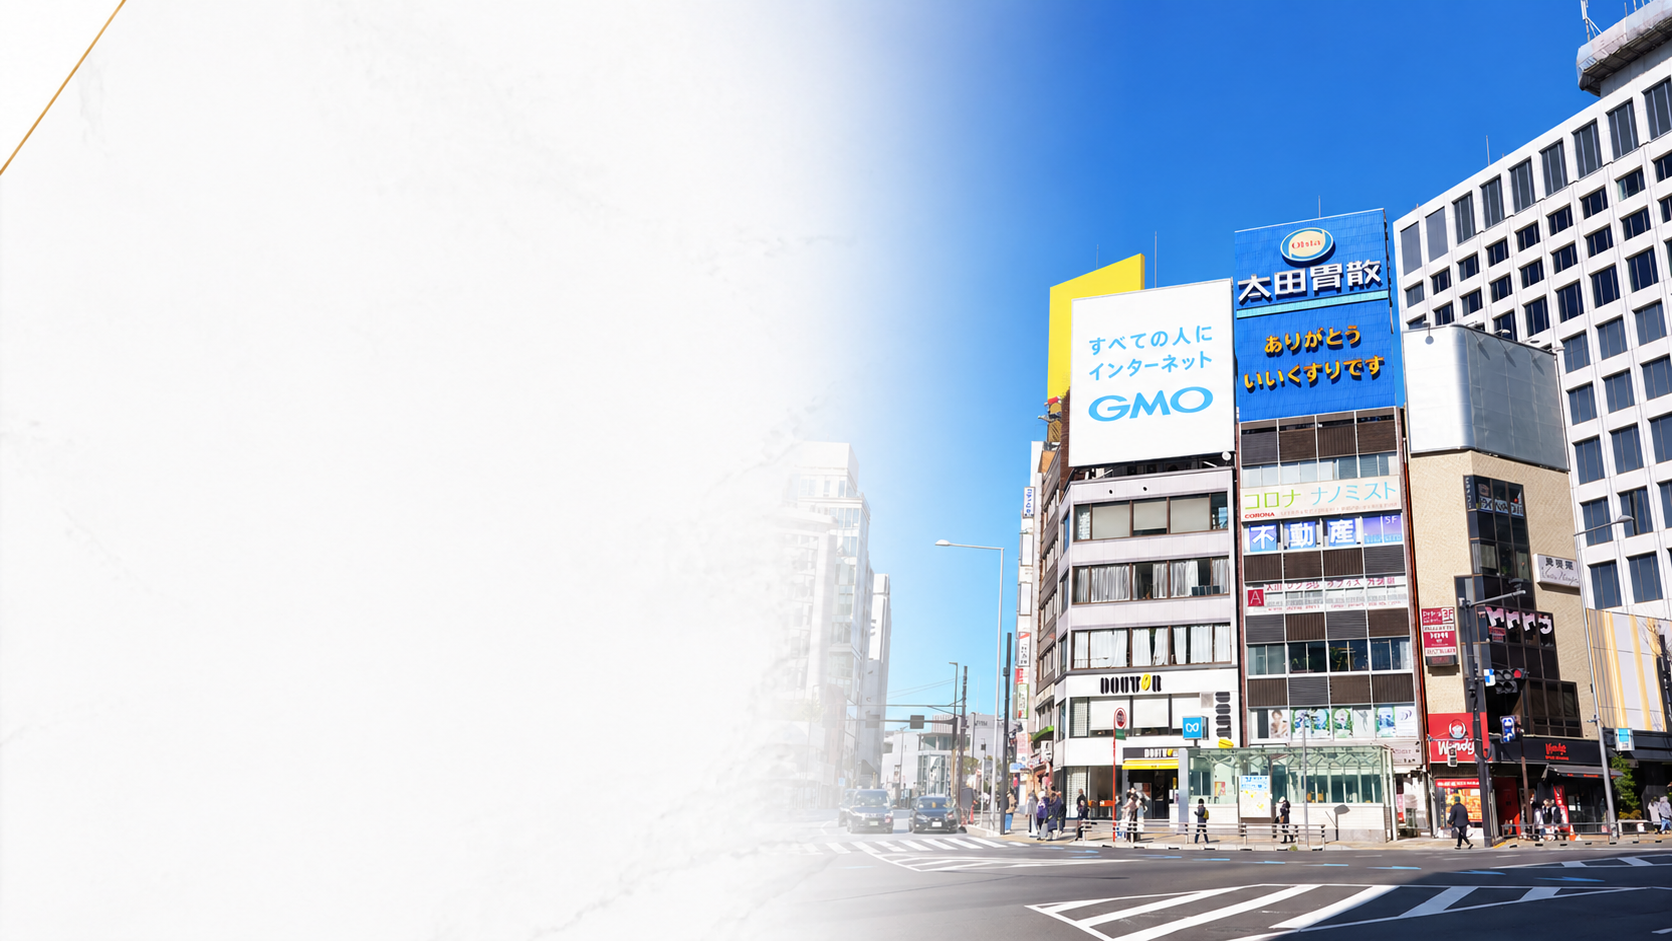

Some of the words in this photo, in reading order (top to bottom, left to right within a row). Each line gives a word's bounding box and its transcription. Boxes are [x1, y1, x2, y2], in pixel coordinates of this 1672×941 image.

[1238, 260, 1381, 302] 太田胃散
[1089, 326, 1213, 356] すべての人に
[1265, 325, 1361, 355] ありがとう
[1089, 351, 1213, 381] インターネット
[1244, 356, 1385, 392] いいくすりです
[1088, 386, 1213, 422] GMO
[1244, 489, 1301, 510] コロナ
[1311, 481, 1396, 506] ナノミスト
[1250, 518, 1355, 549] 不動産
[1250, 590, 1262, 605] A
[1100, 673, 1162, 695] DOUTOR
